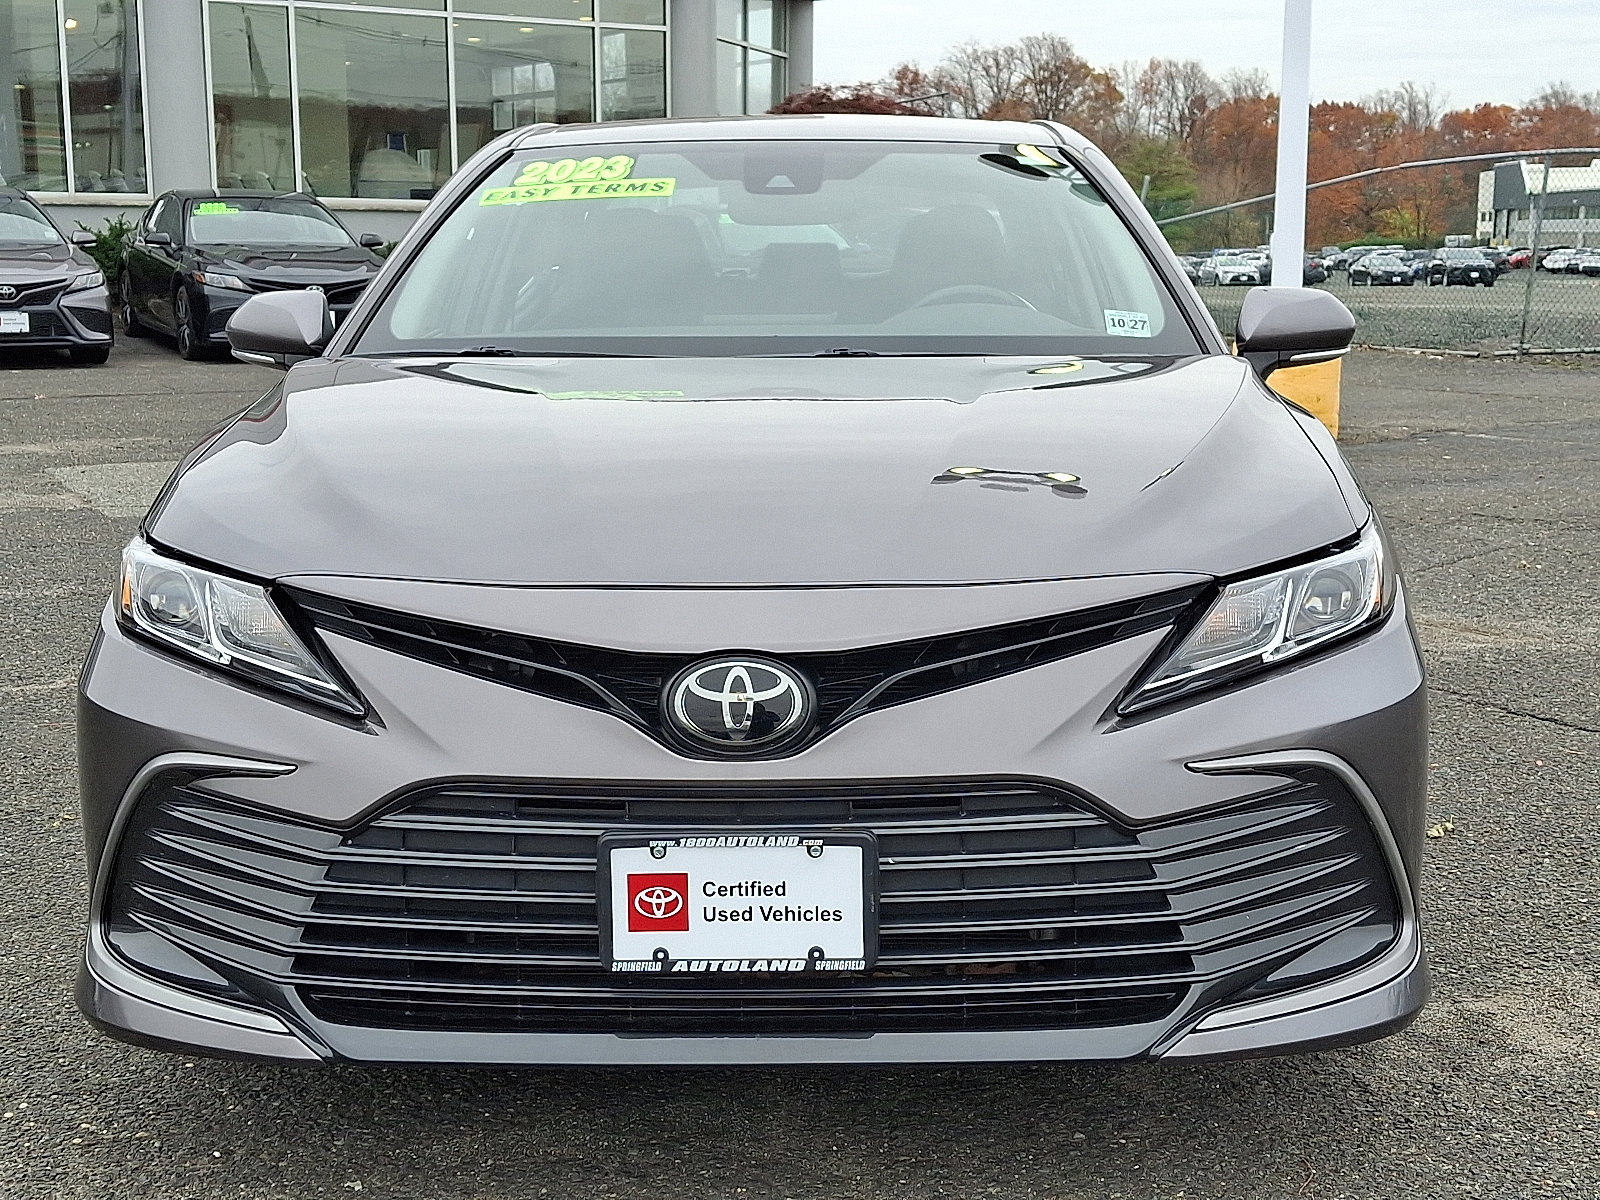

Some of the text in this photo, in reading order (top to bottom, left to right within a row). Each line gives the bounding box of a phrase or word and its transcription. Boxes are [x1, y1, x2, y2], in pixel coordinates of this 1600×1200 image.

[513, 155, 635, 186] 2023
[483, 181, 669, 202] EASY TERMS
[1110, 317, 1147, 330] 10 27
[649, 836, 823, 847] www.1800AUTOLAND.com
[702, 880, 787, 897] Certified
[702, 905, 843, 922] Used Vehicles
[611, 960, 866, 972] SPRINGFIELD AUTOLAND SPRINGFIELD
